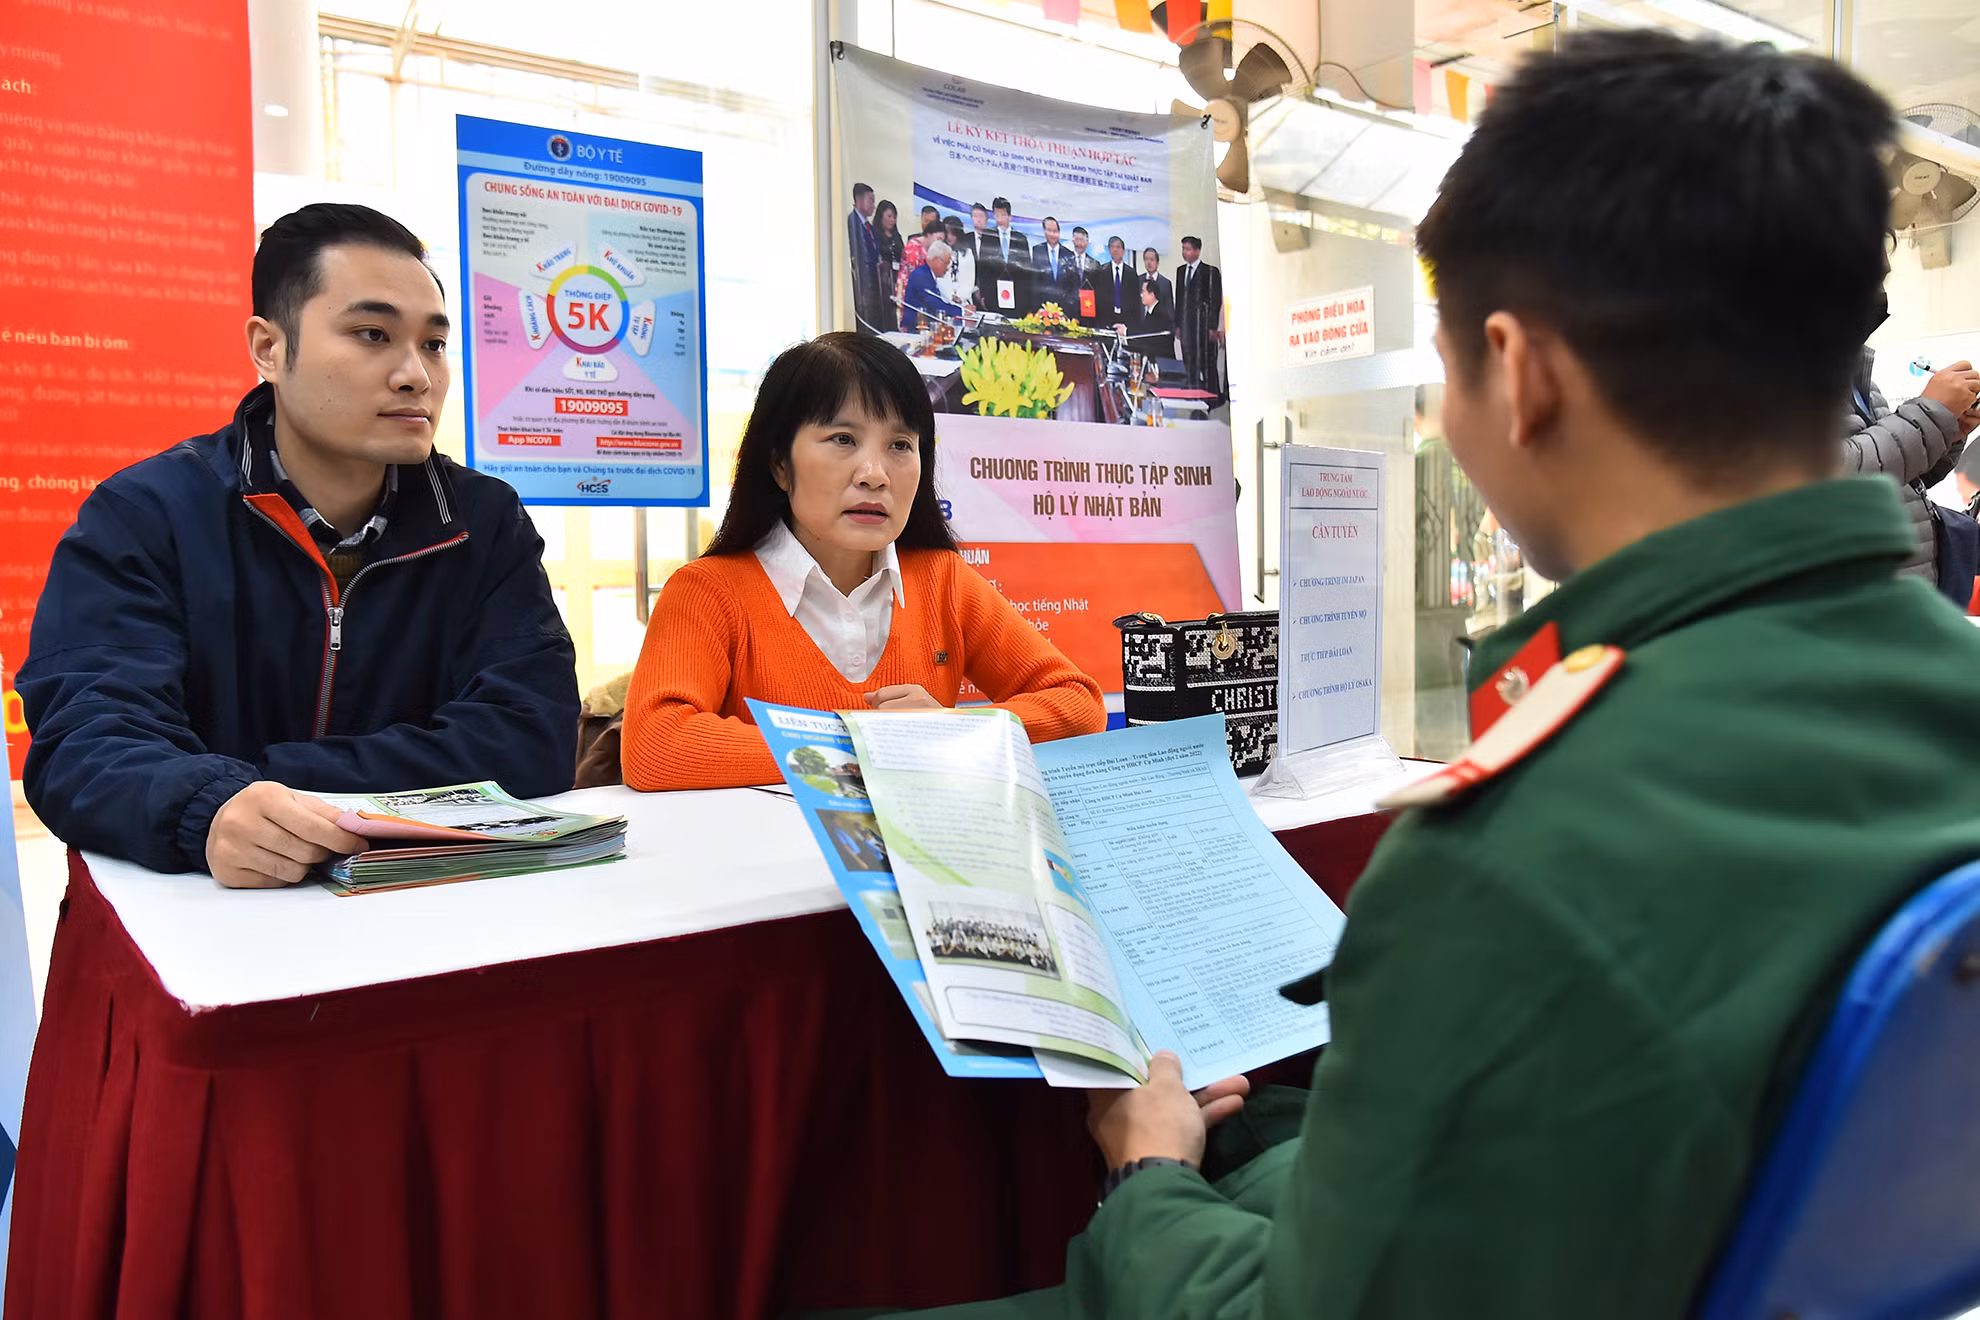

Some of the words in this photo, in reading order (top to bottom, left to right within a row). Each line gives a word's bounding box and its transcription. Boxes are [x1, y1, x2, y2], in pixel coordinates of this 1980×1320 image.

[947, 116, 963, 133] LỄ
[965, 123, 982, 138] KÝ
[985, 127, 1008, 144] KẾT
[1013, 134, 1044, 152] THỎA
[1048, 140, 1087, 159] THUẬN
[1113, 152, 1136, 166] TÁC
[577, 145, 595, 162] BỘ
[598, 147, 607, 161] Y
[607, 145, 623, 163] TẾ
[524, 161, 555, 176] Đường
[558, 166, 576, 179] dây
[578, 167, 602, 180] nóng:
[604, 172, 646, 186] 19009095
[484, 181, 517, 195] CHUNG
[520, 182, 544, 199] SỐNG
[547, 190, 559, 200] AN
[562, 189, 585, 204] TOÀN
[588, 190, 602, 206] VỚI
[604, 197, 620, 209] ĐẠI
[622, 199, 641, 212] DỊCH
[644, 202, 682, 216] COVID-19
[564, 288, 593, 299] THÔNG
[568, 302, 610, 332] 5K
[1292, 308, 1320, 325] PHÒNG
[1324, 301, 1344, 318] ĐIỀU
[1347, 298, 1365, 314] HÒA
[1290, 335, 1300, 346] RA
[1303, 330, 1319, 344] VÀO
[1323, 325, 1347, 342] ĐÓNG
[1350, 319, 1368, 336] CỬA
[560, 400, 624, 414] 19009095
[508, 436, 525, 445] App
[526, 436, 552, 444] NCOVI
[583, 466, 606, 476] Chúng
[970, 456, 1038, 481] CHƯƠNG
[1044, 457, 1090, 483] TRÌNH
[1095, 463, 1134, 488] THỰC
[1139, 462, 1168, 489] TẬP
[1174, 466, 1212, 486] SINH
[1319, 472, 1339, 483] TRUNG
[1340, 471, 1352, 483] TÂM
[1302, 488, 1314, 498] LAO
[1315, 488, 1332, 500] ĐỘNG
[1033, 491, 1055, 520] HỘ
[1060, 493, 1079, 517] LÝ
[1084, 493, 1123, 521] NHẬT
[1130, 491, 1161, 517] BẢN
[1312, 523, 1330, 538] CẦN
[1332, 523, 1358, 538] TUYỂN
[1300, 577, 1324, 588] CHƯƠNG
[1325, 576, 1341, 586] TRÌNH
[1349, 575, 1364, 584] JAPAN
[1033, 598, 1060, 614] tiếng
[1063, 598, 1089, 612] Nhật
[1300, 614, 1323, 625] CHƯƠNG
[1324, 612, 1341, 623] TRÌNH
[1298, 688, 1322, 700] CHƯƠNG
[1323, 684, 1340, 696] TRÌNH
[1356, 679, 1372, 690] OSAKA
